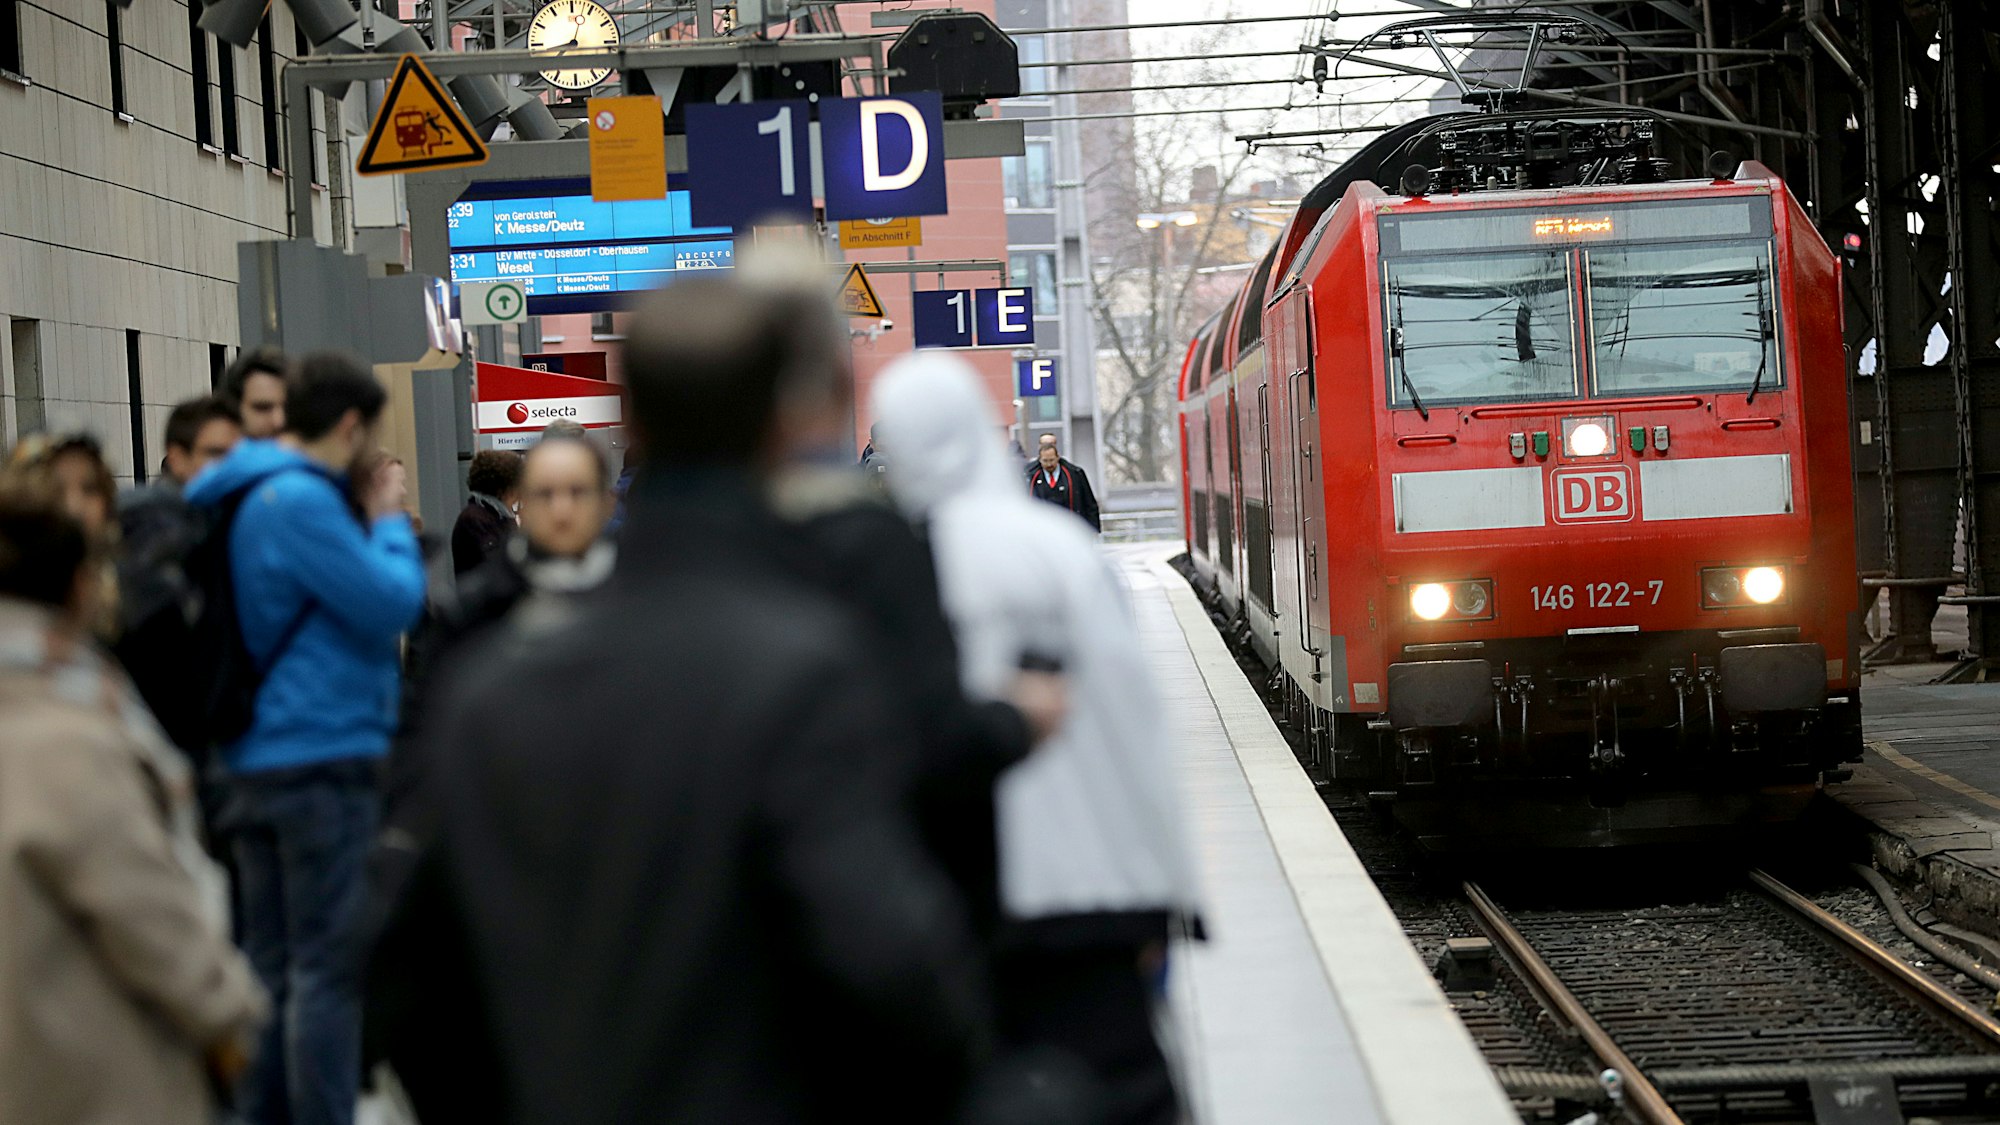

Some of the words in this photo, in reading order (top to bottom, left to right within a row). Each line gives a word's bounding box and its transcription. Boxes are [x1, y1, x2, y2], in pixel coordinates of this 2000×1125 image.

[758, 106, 795, 196] 1
[860, 99, 929, 191] D
[494, 213, 510, 221] von
[512, 210, 557, 221] Gerolstein
[494, 222, 504, 235] K
[507, 219, 585, 234] Messe/Deutz
[849, 234, 860, 243] im
[862, 232, 904, 242] Abschnitt
[905, 231, 912, 240] F
[496, 251, 511, 262] LEV
[513, 250, 537, 261] Mitte
[544, 247, 591, 259] Düsseldorf
[598, 246, 649, 256] Oberhausen
[497, 261, 534, 274] Wesel
[947, 292, 965, 334] 1
[997, 289, 1027, 332] E
[1032, 359, 1052, 390] F
[531, 406, 577, 418] selecta
[1562, 475, 1623, 514] DB
[1530, 584, 1574, 611] 146
[1585, 580, 1664, 608] 122-7
